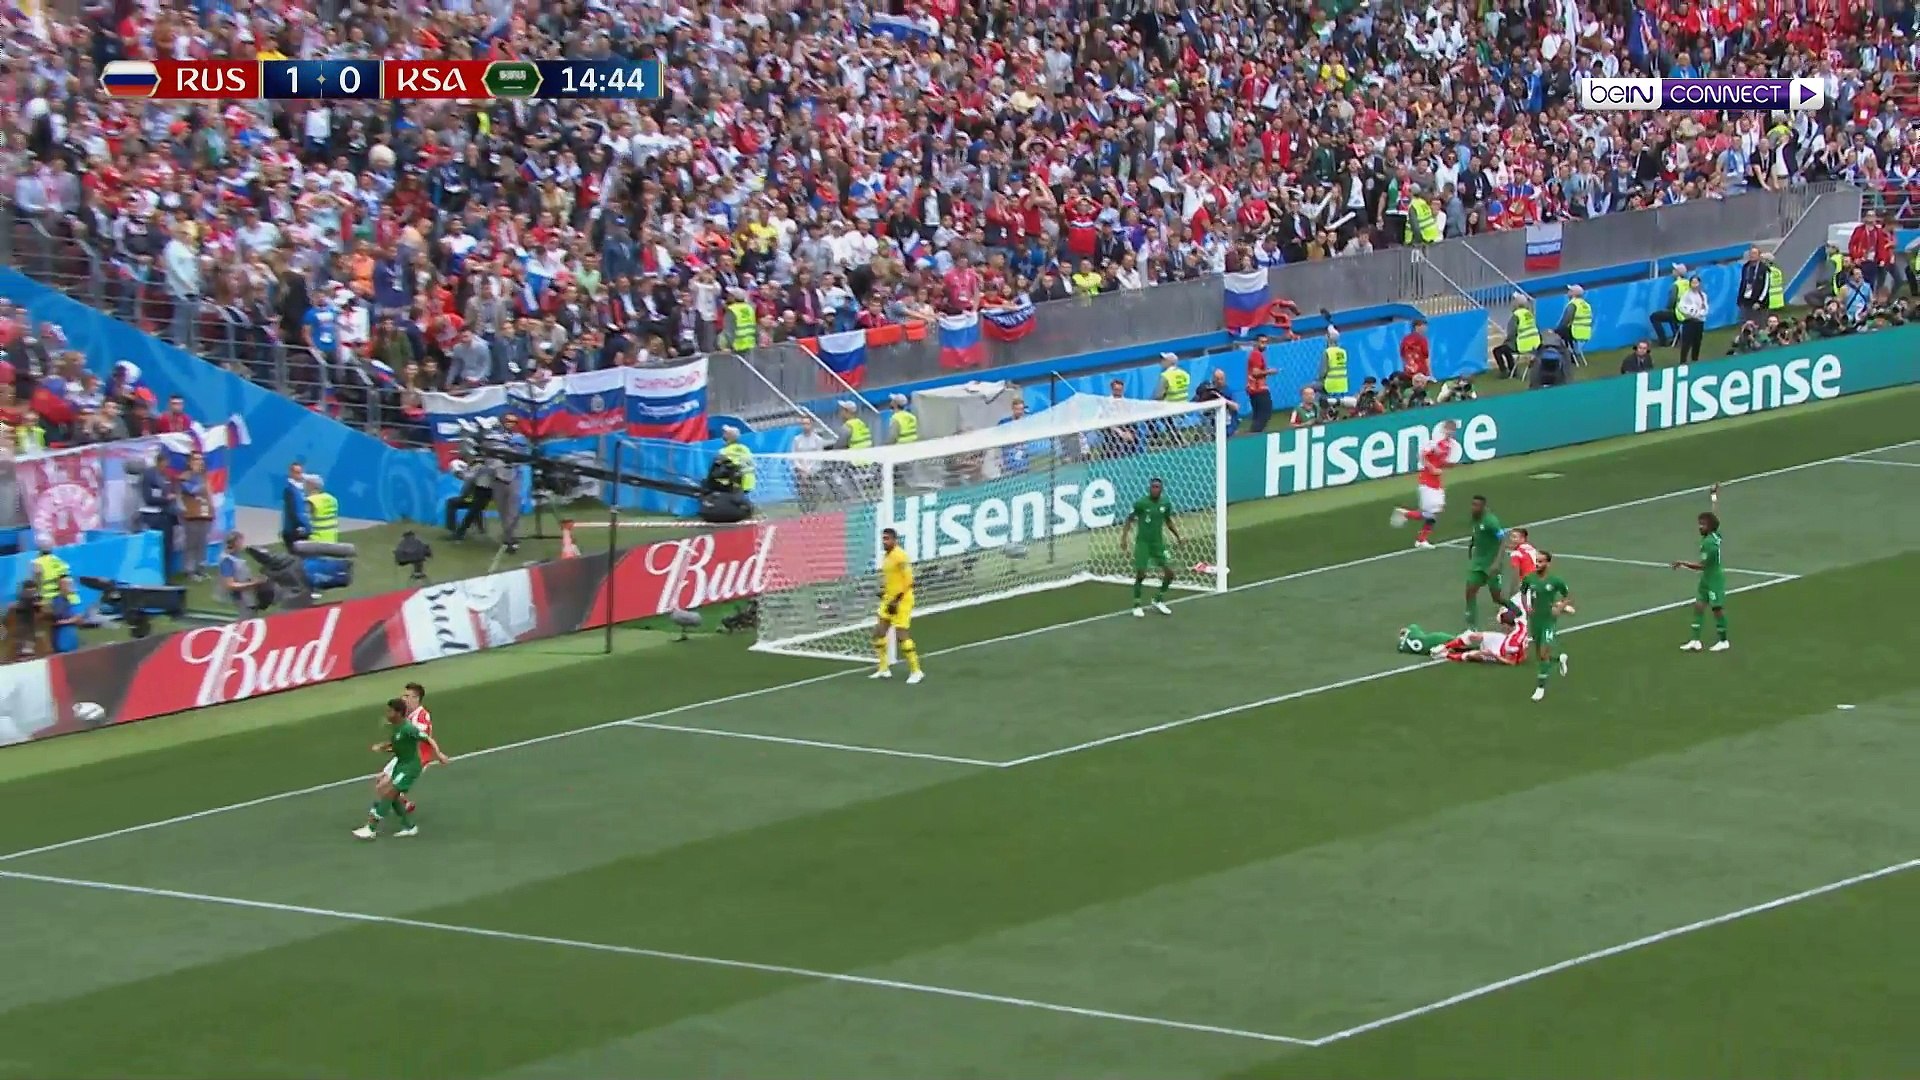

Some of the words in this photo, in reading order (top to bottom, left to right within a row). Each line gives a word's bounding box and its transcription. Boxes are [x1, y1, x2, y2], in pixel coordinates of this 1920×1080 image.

[1635, 353, 1842, 433] Hisense
[1264, 414, 1498, 497] Hisense
[876, 478, 1116, 568] Hisense
[644, 525, 778, 615] Bud
[180, 608, 341, 708] Bud
